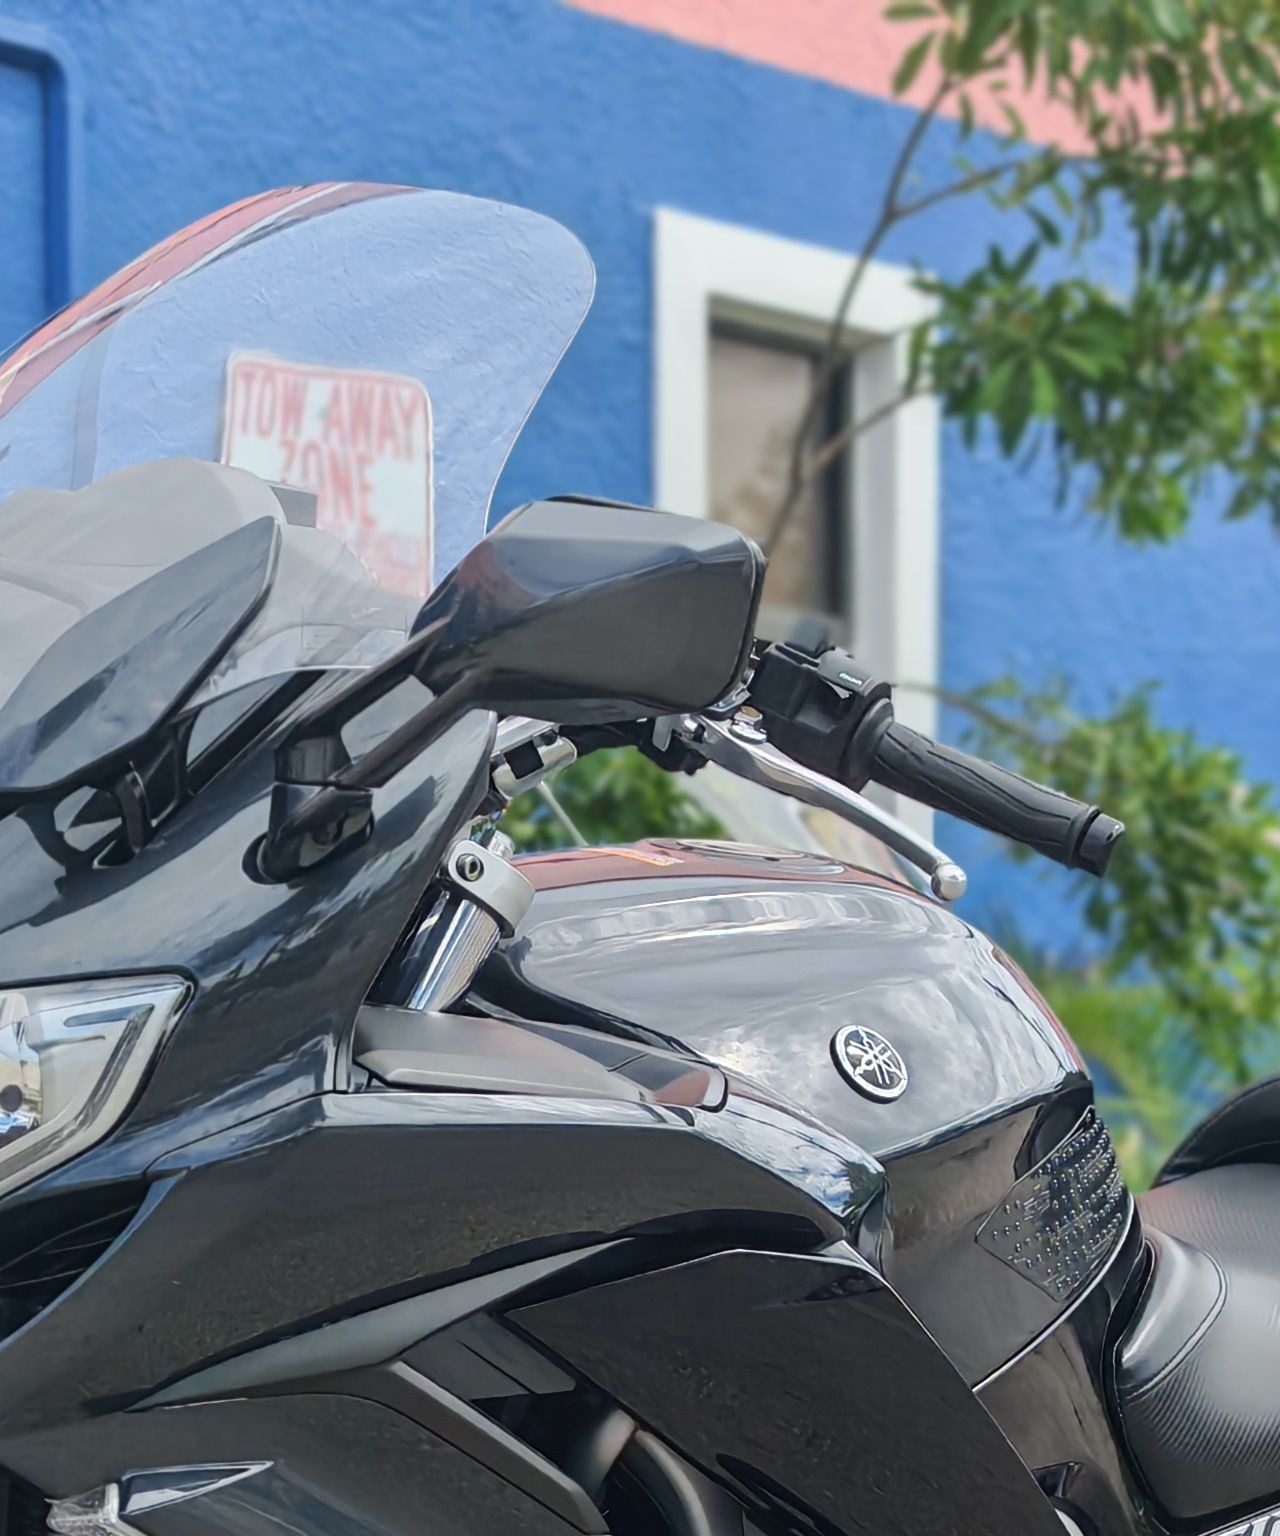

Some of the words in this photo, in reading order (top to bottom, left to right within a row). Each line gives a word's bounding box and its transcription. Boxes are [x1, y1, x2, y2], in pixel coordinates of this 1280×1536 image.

[240, 369, 307, 439] TOW
[321, 379, 422, 463] AWAY
[280, 438, 379, 529] ZONE
